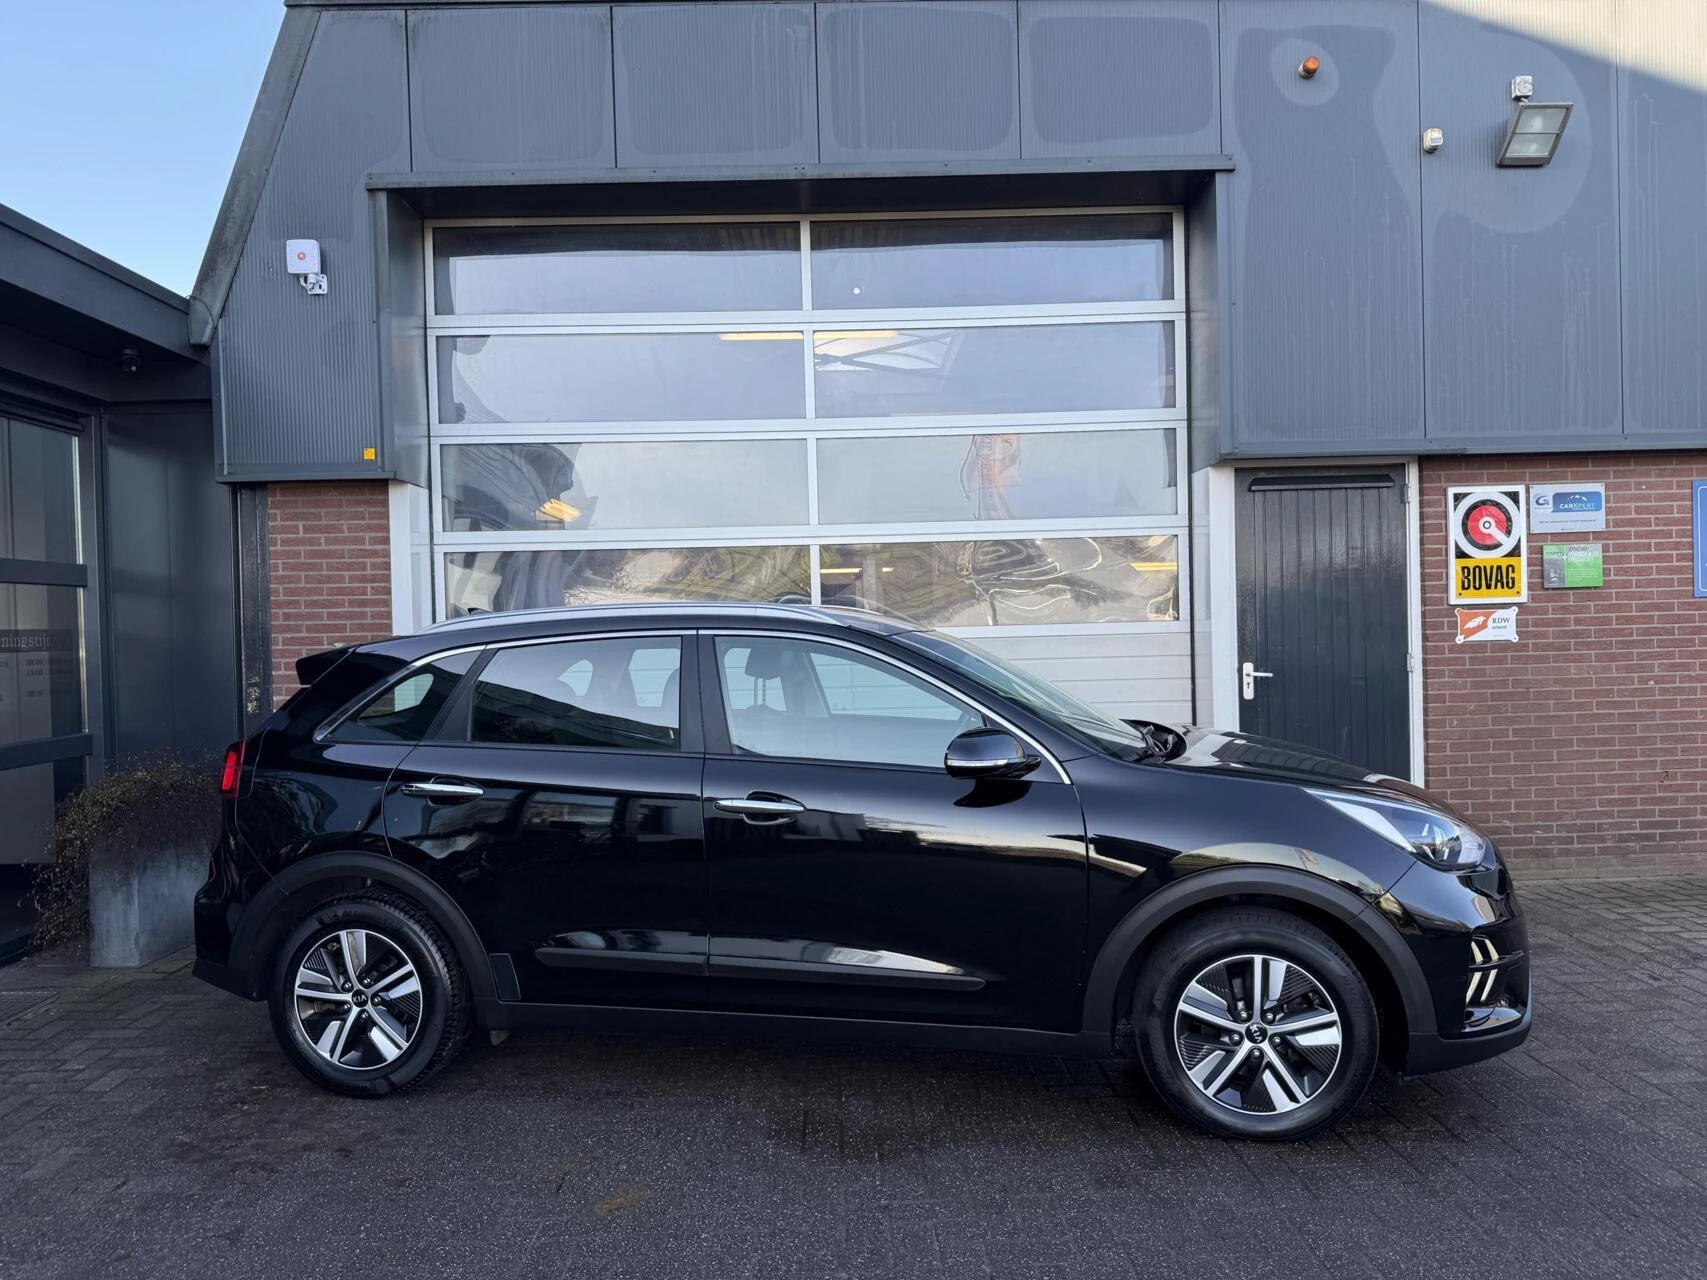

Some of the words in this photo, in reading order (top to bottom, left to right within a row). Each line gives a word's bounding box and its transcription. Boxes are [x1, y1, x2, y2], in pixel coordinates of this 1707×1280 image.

[1461, 564, 1516, 591] BOVAG
[352, 995, 367, 1003] KIA
[1250, 1024, 1262, 1043] KIA
